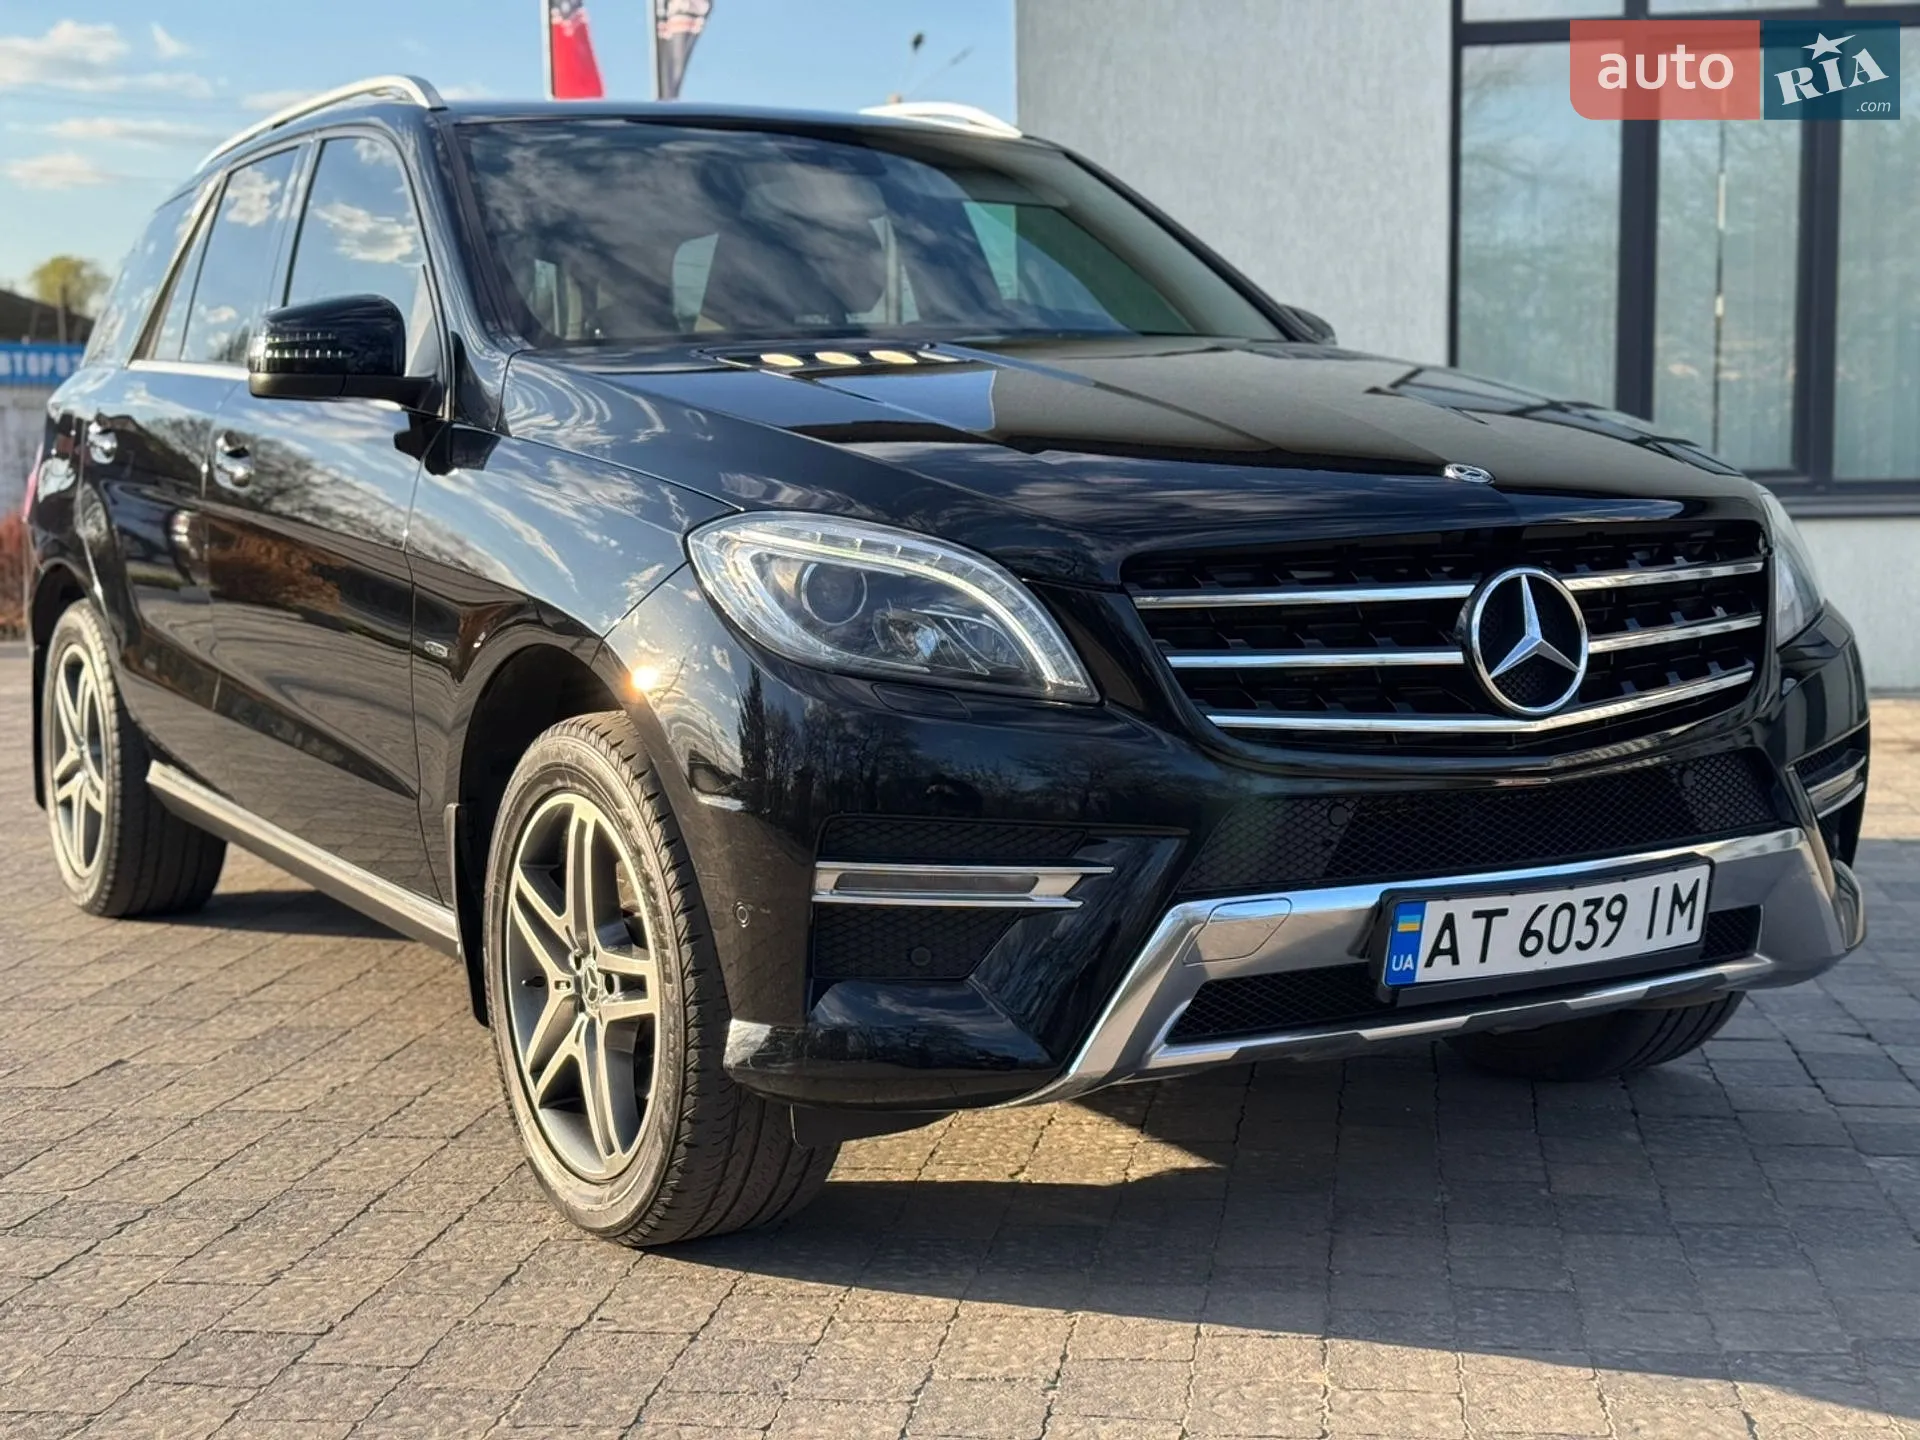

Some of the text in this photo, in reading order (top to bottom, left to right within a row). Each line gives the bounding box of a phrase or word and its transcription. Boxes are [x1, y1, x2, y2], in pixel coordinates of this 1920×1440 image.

[1424, 878, 1700, 968] AT 6039 IM
[1391, 954, 1415, 971] UA
